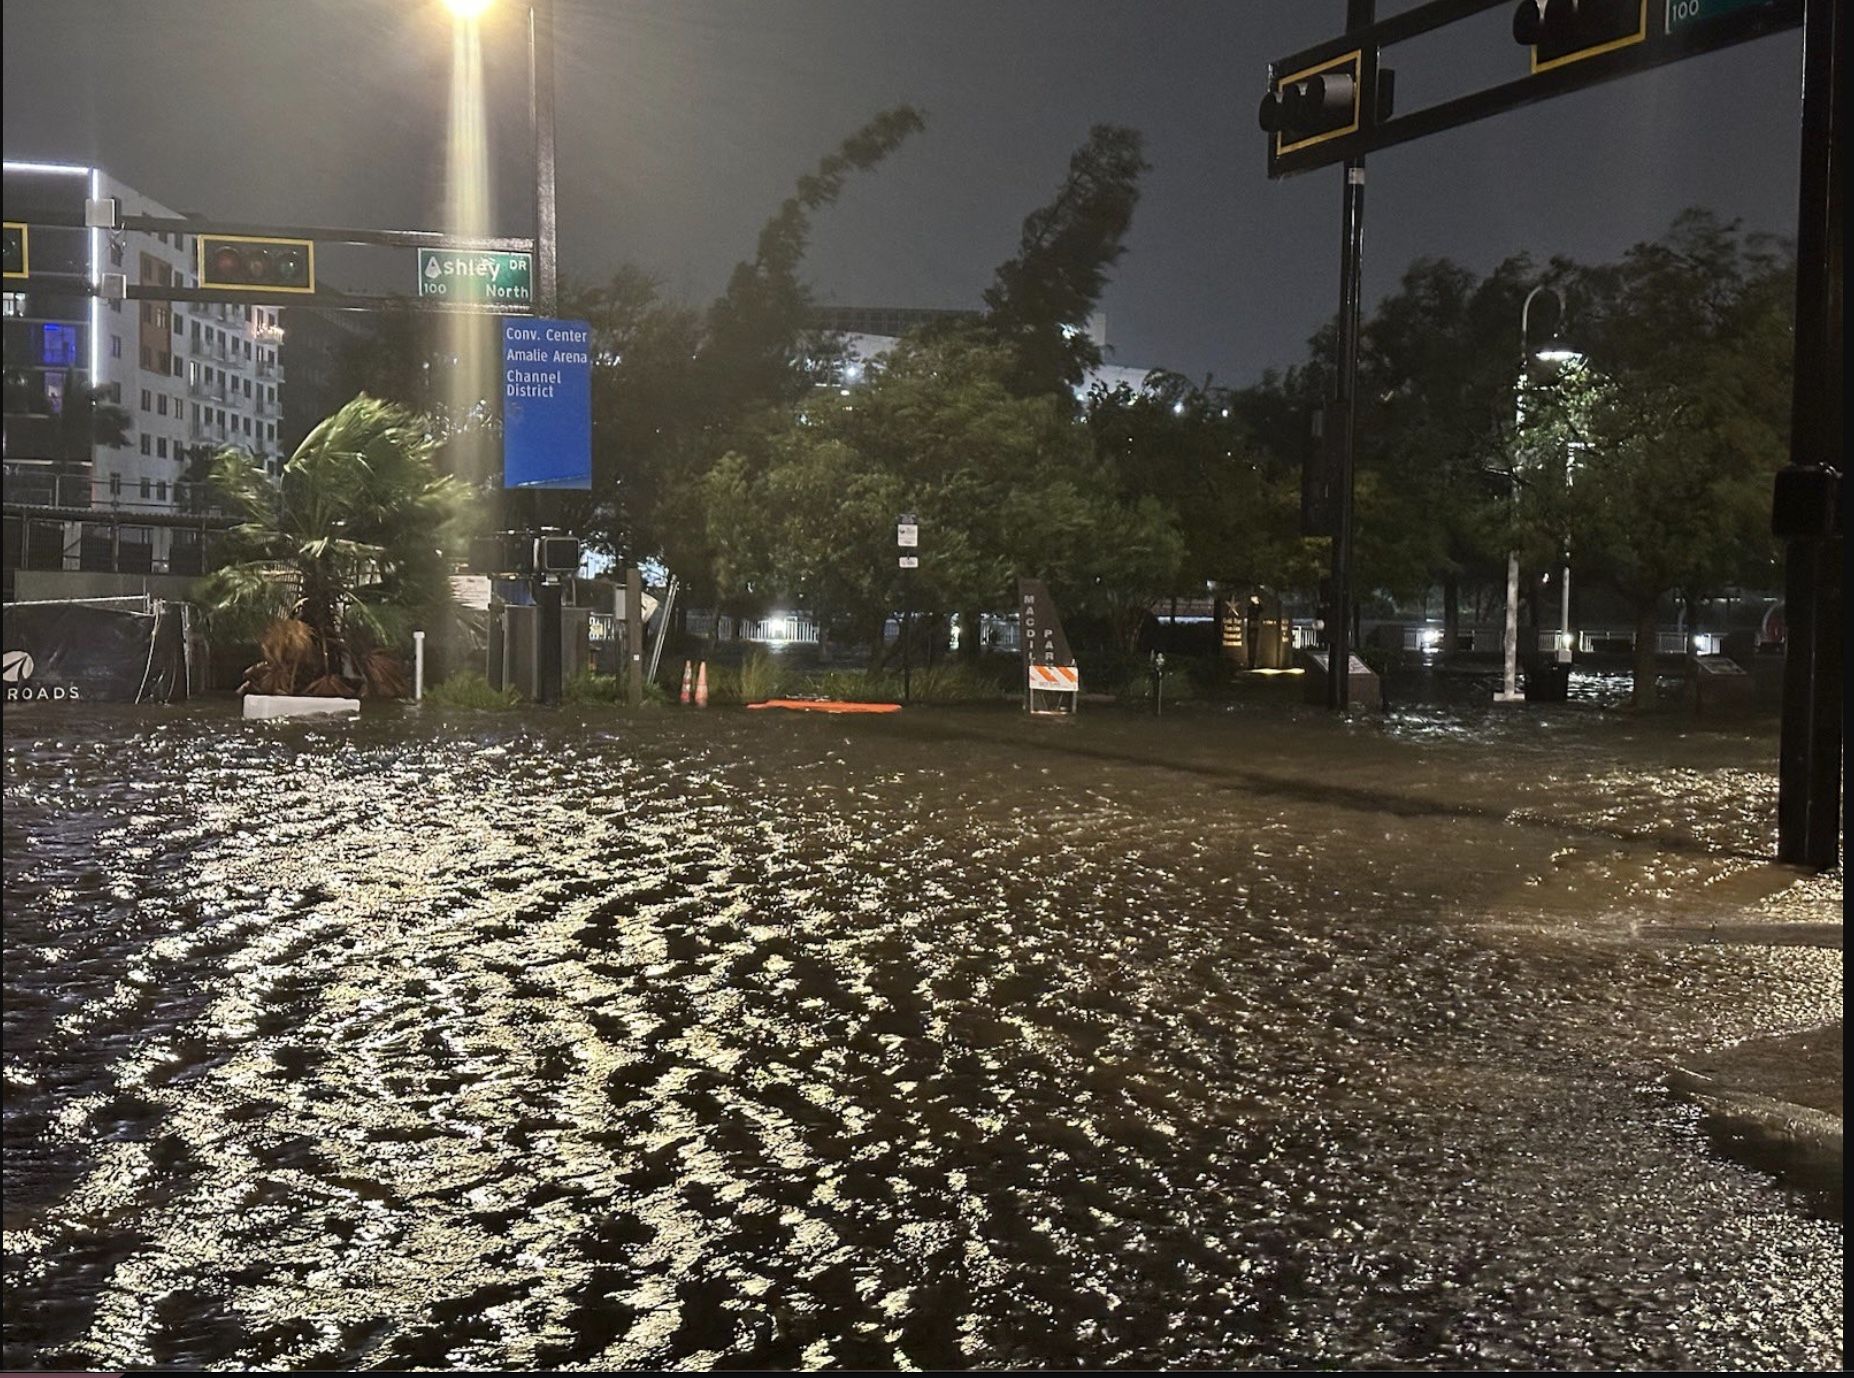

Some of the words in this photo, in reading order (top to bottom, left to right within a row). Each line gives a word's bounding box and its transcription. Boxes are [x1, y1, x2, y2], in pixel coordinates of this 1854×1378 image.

[1672, 0, 1699, 21] 100
[424, 256, 500, 282] Ashley
[509, 259, 527, 271] DR
[424, 283, 447, 294] 100
[486, 284, 529, 298] North
[506, 327, 541, 341] Conv.
[546, 328, 588, 343] Center
[506, 348, 548, 362] Amalie
[553, 350, 587, 364] Arena
[506, 369, 562, 384] Channel
[506, 383, 553, 398] District
[7, 686, 80, 700] ROADS
